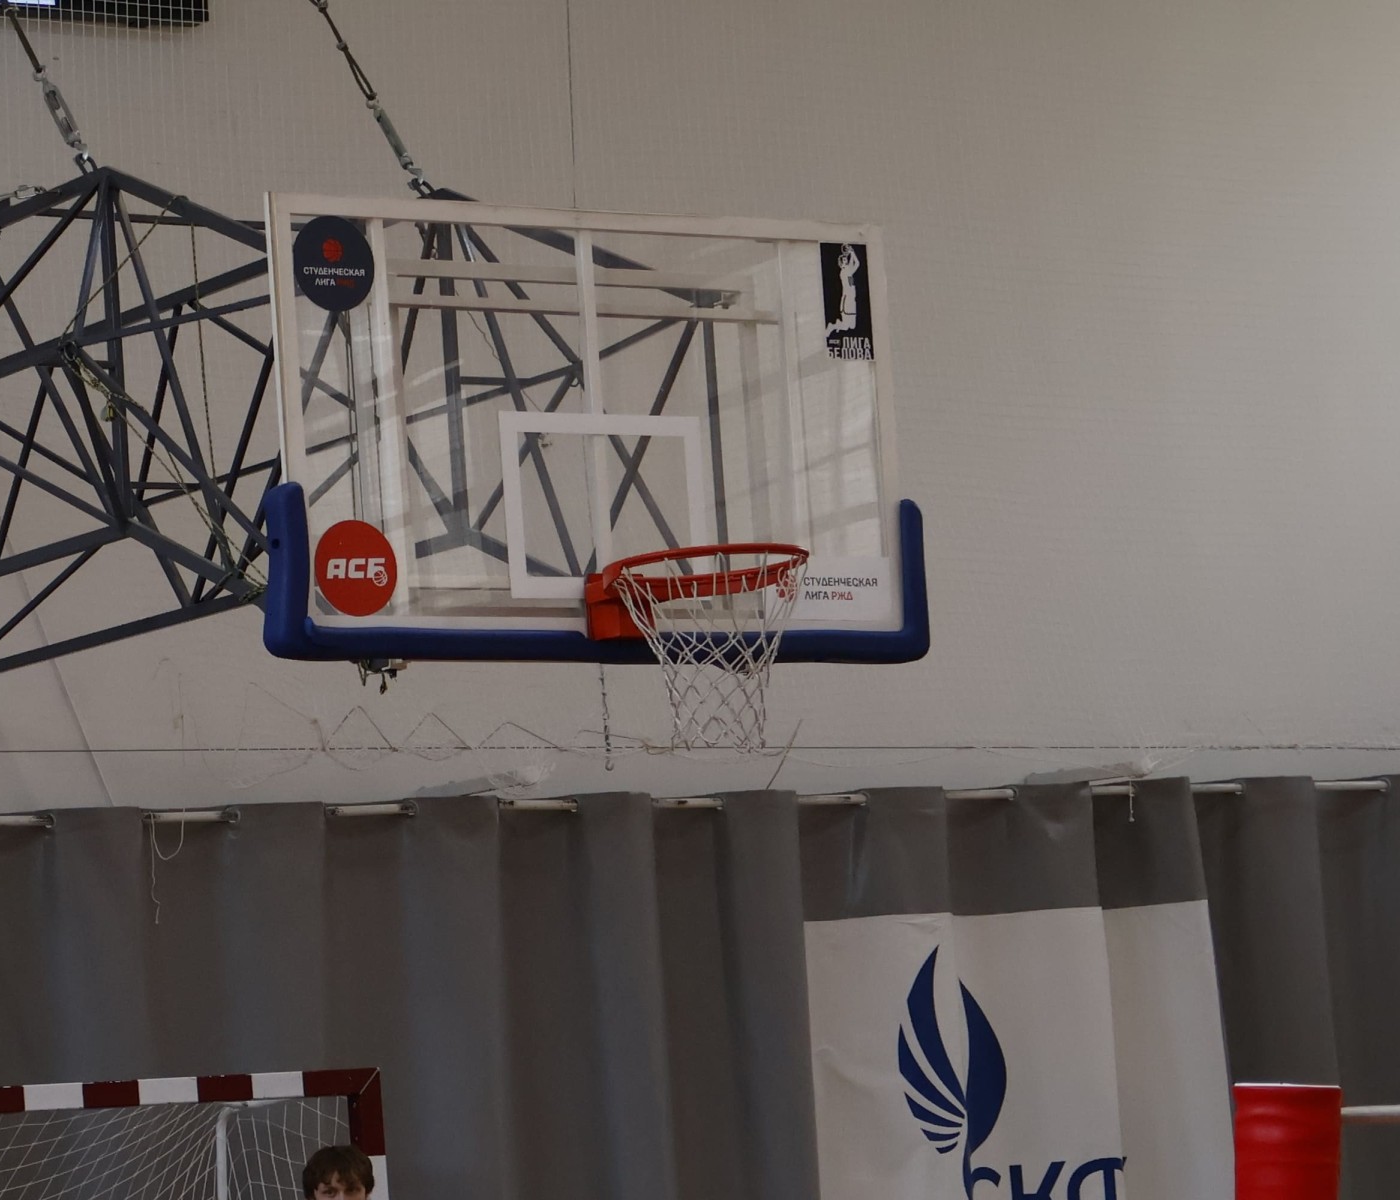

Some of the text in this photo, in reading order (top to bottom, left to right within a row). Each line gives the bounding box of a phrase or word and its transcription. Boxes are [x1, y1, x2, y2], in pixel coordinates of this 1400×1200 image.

[303, 266, 366, 277] СТУДЕНЧЕСКАЯ
[315, 278, 336, 287] ЛИГА
[842, 336, 871, 349] ЛИГА
[803, 576, 878, 587] СТУДЕНЧЕСКАЯ
[804, 590, 854, 601] ЛИГА РЖД
